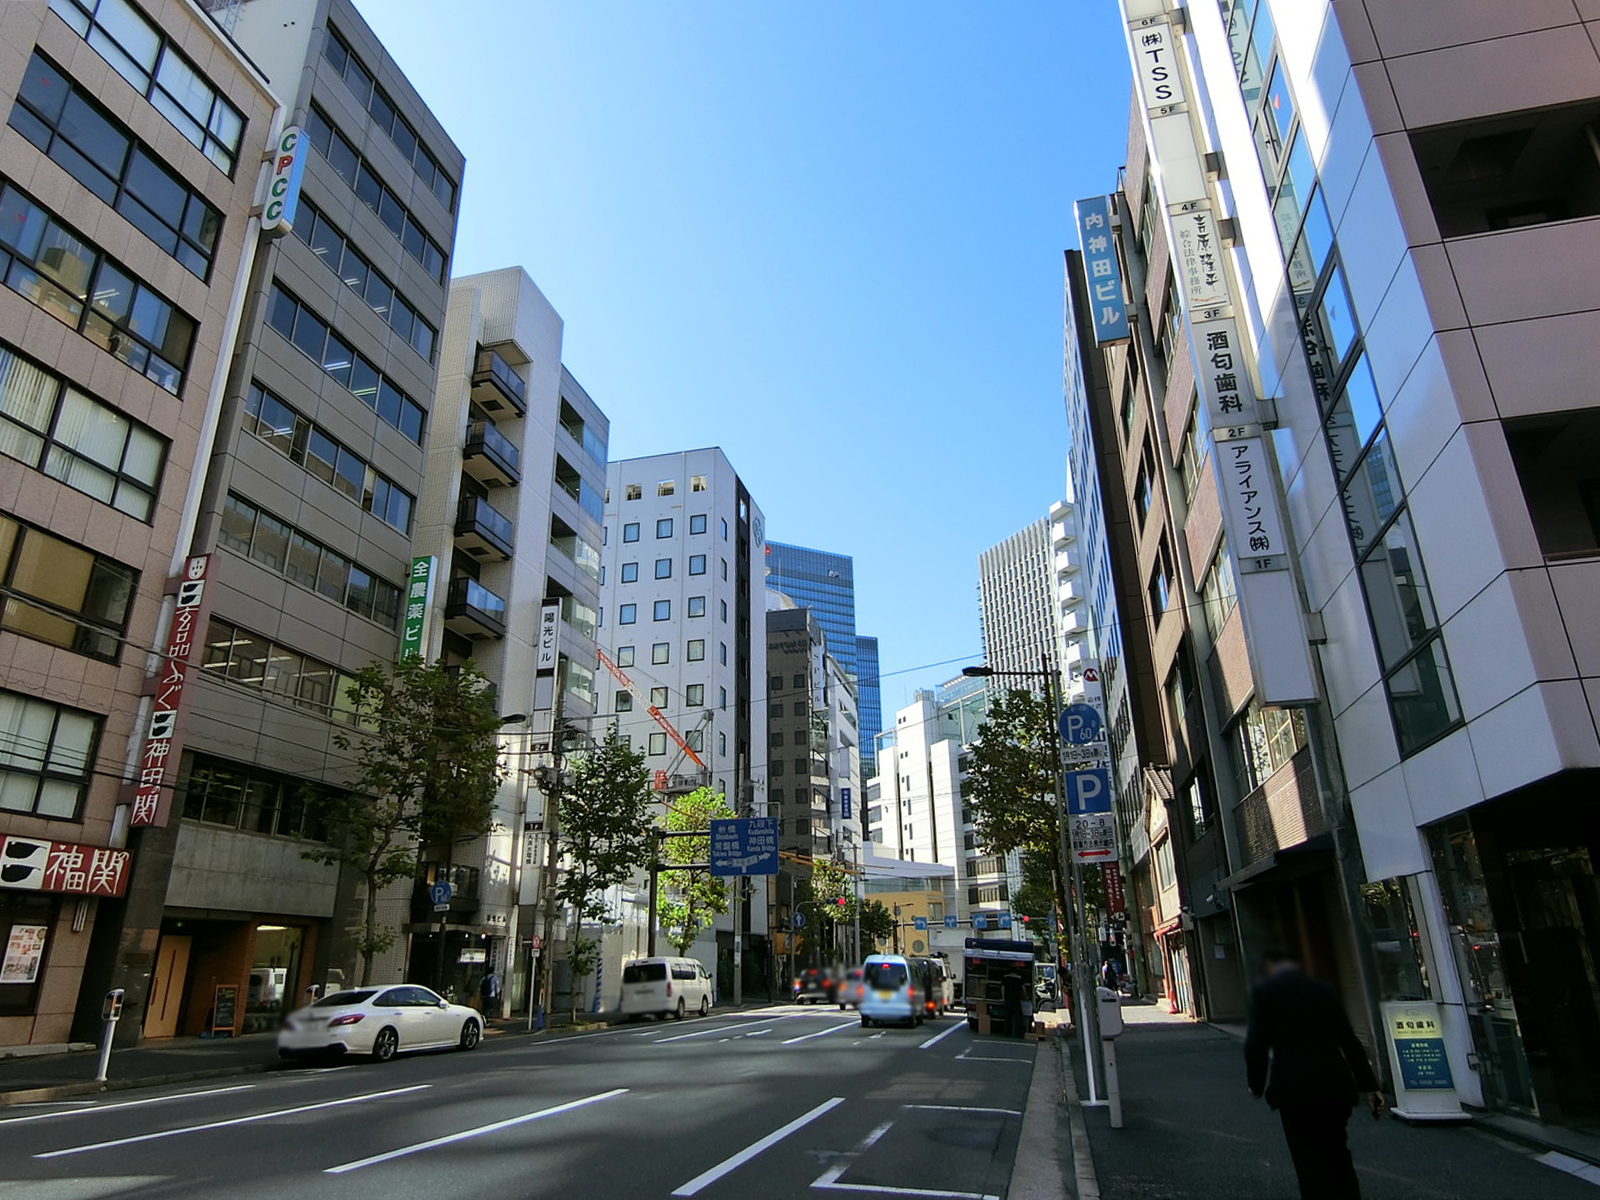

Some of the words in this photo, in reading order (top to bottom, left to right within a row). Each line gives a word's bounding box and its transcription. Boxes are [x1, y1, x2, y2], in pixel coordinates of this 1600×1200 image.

[1141, 17, 1156, 26] 6F
[1160, 105, 1175, 115] 5F
[266, 133, 297, 220] CPCC
[1181, 202, 1197, 211] 4F
[1084, 212, 1120, 325] 内神田ビル
[1203, 309, 1220, 319] 3F
[1206, 330, 1243, 414] 酒匂歯科
[1228, 427, 1246, 437] 2F
[1255, 558, 1272, 569] 1F
[541, 612, 554, 662] 陽光ビル
[1067, 714, 1084, 742] P
[1080, 727, 1092, 740] 60
[1076, 774, 1102, 811] P
[748, 819, 774, 829] 九段下
[748, 836, 774, 845] 神田橋
